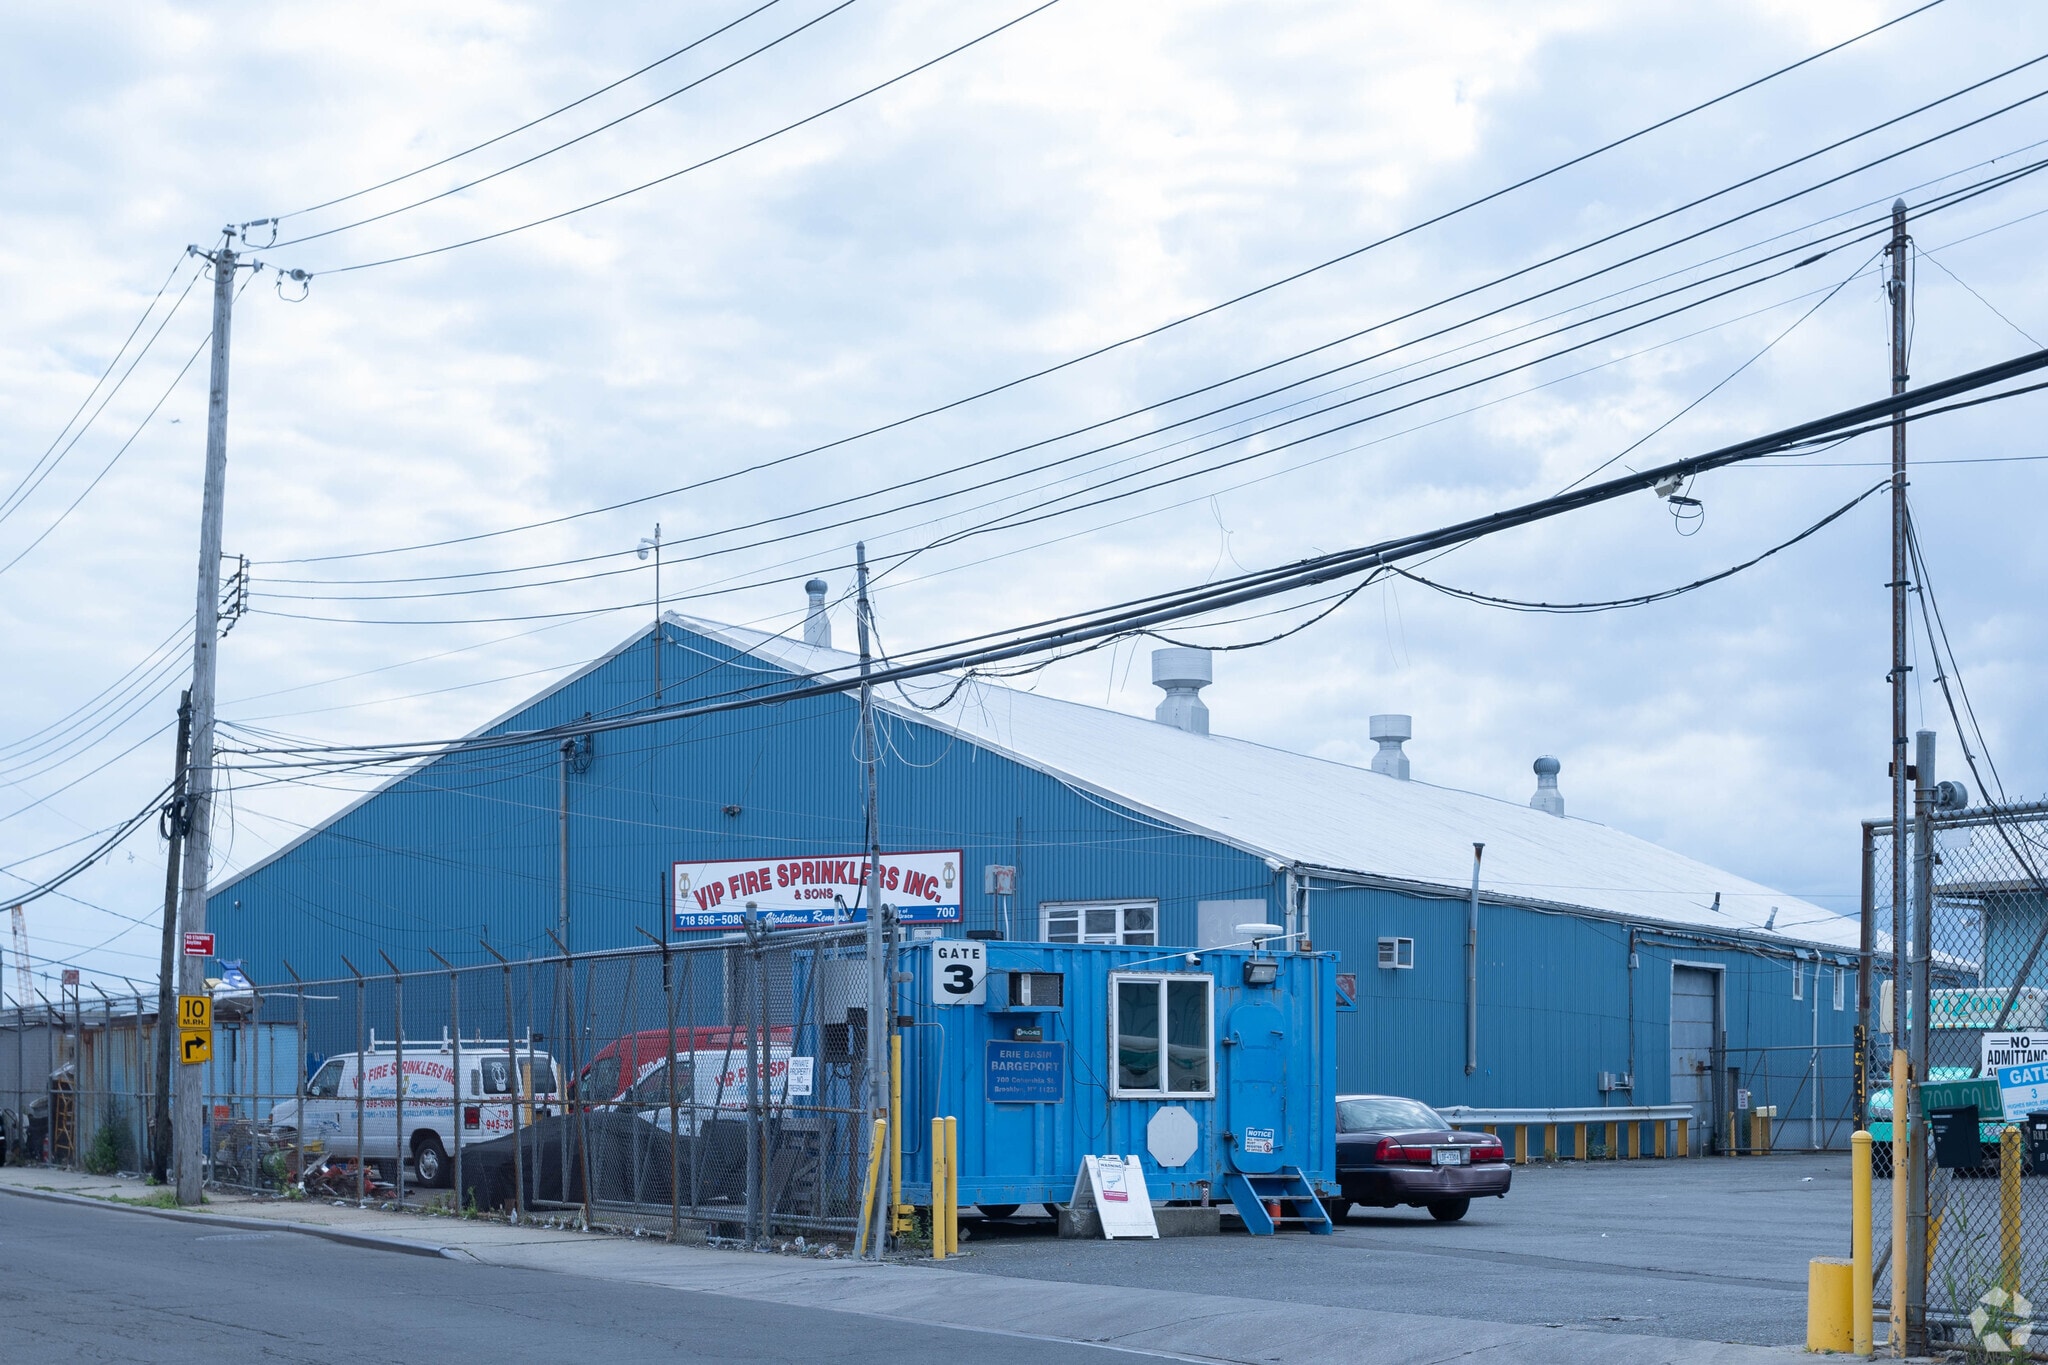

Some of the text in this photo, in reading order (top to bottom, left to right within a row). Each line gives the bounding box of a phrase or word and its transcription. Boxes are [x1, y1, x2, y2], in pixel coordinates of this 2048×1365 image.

[693, 860, 941, 911] VIP FIRE SPRINKLERS INC.
[794, 888, 833, 900] & SONS
[936, 907, 955, 918] 700
[680, 915, 695, 925] 718
[938, 947, 980, 959] GATE
[943, 964, 974, 994] 3
[185, 1000, 204, 1018] 10
[2011, 1036, 2030, 1048] NO
[1000, 1050, 1052, 1059] ERIE BASIN
[1987, 1049, 2048, 1065] ADMITTANC
[991, 1060, 1059, 1071] BARGEPORT
[352, 1071, 366, 1089] VP
[368, 1063, 389, 1082] FIRE
[390, 1060, 444, 1078] SRINKLERS
[738, 1063, 763, 1083] FE
[2010, 1066, 2048, 1084] GATE
[2031, 1088, 2037, 1098] 3
[498, 1110, 509, 1118] 718
[486, 1119, 513, 1130] 945-33
